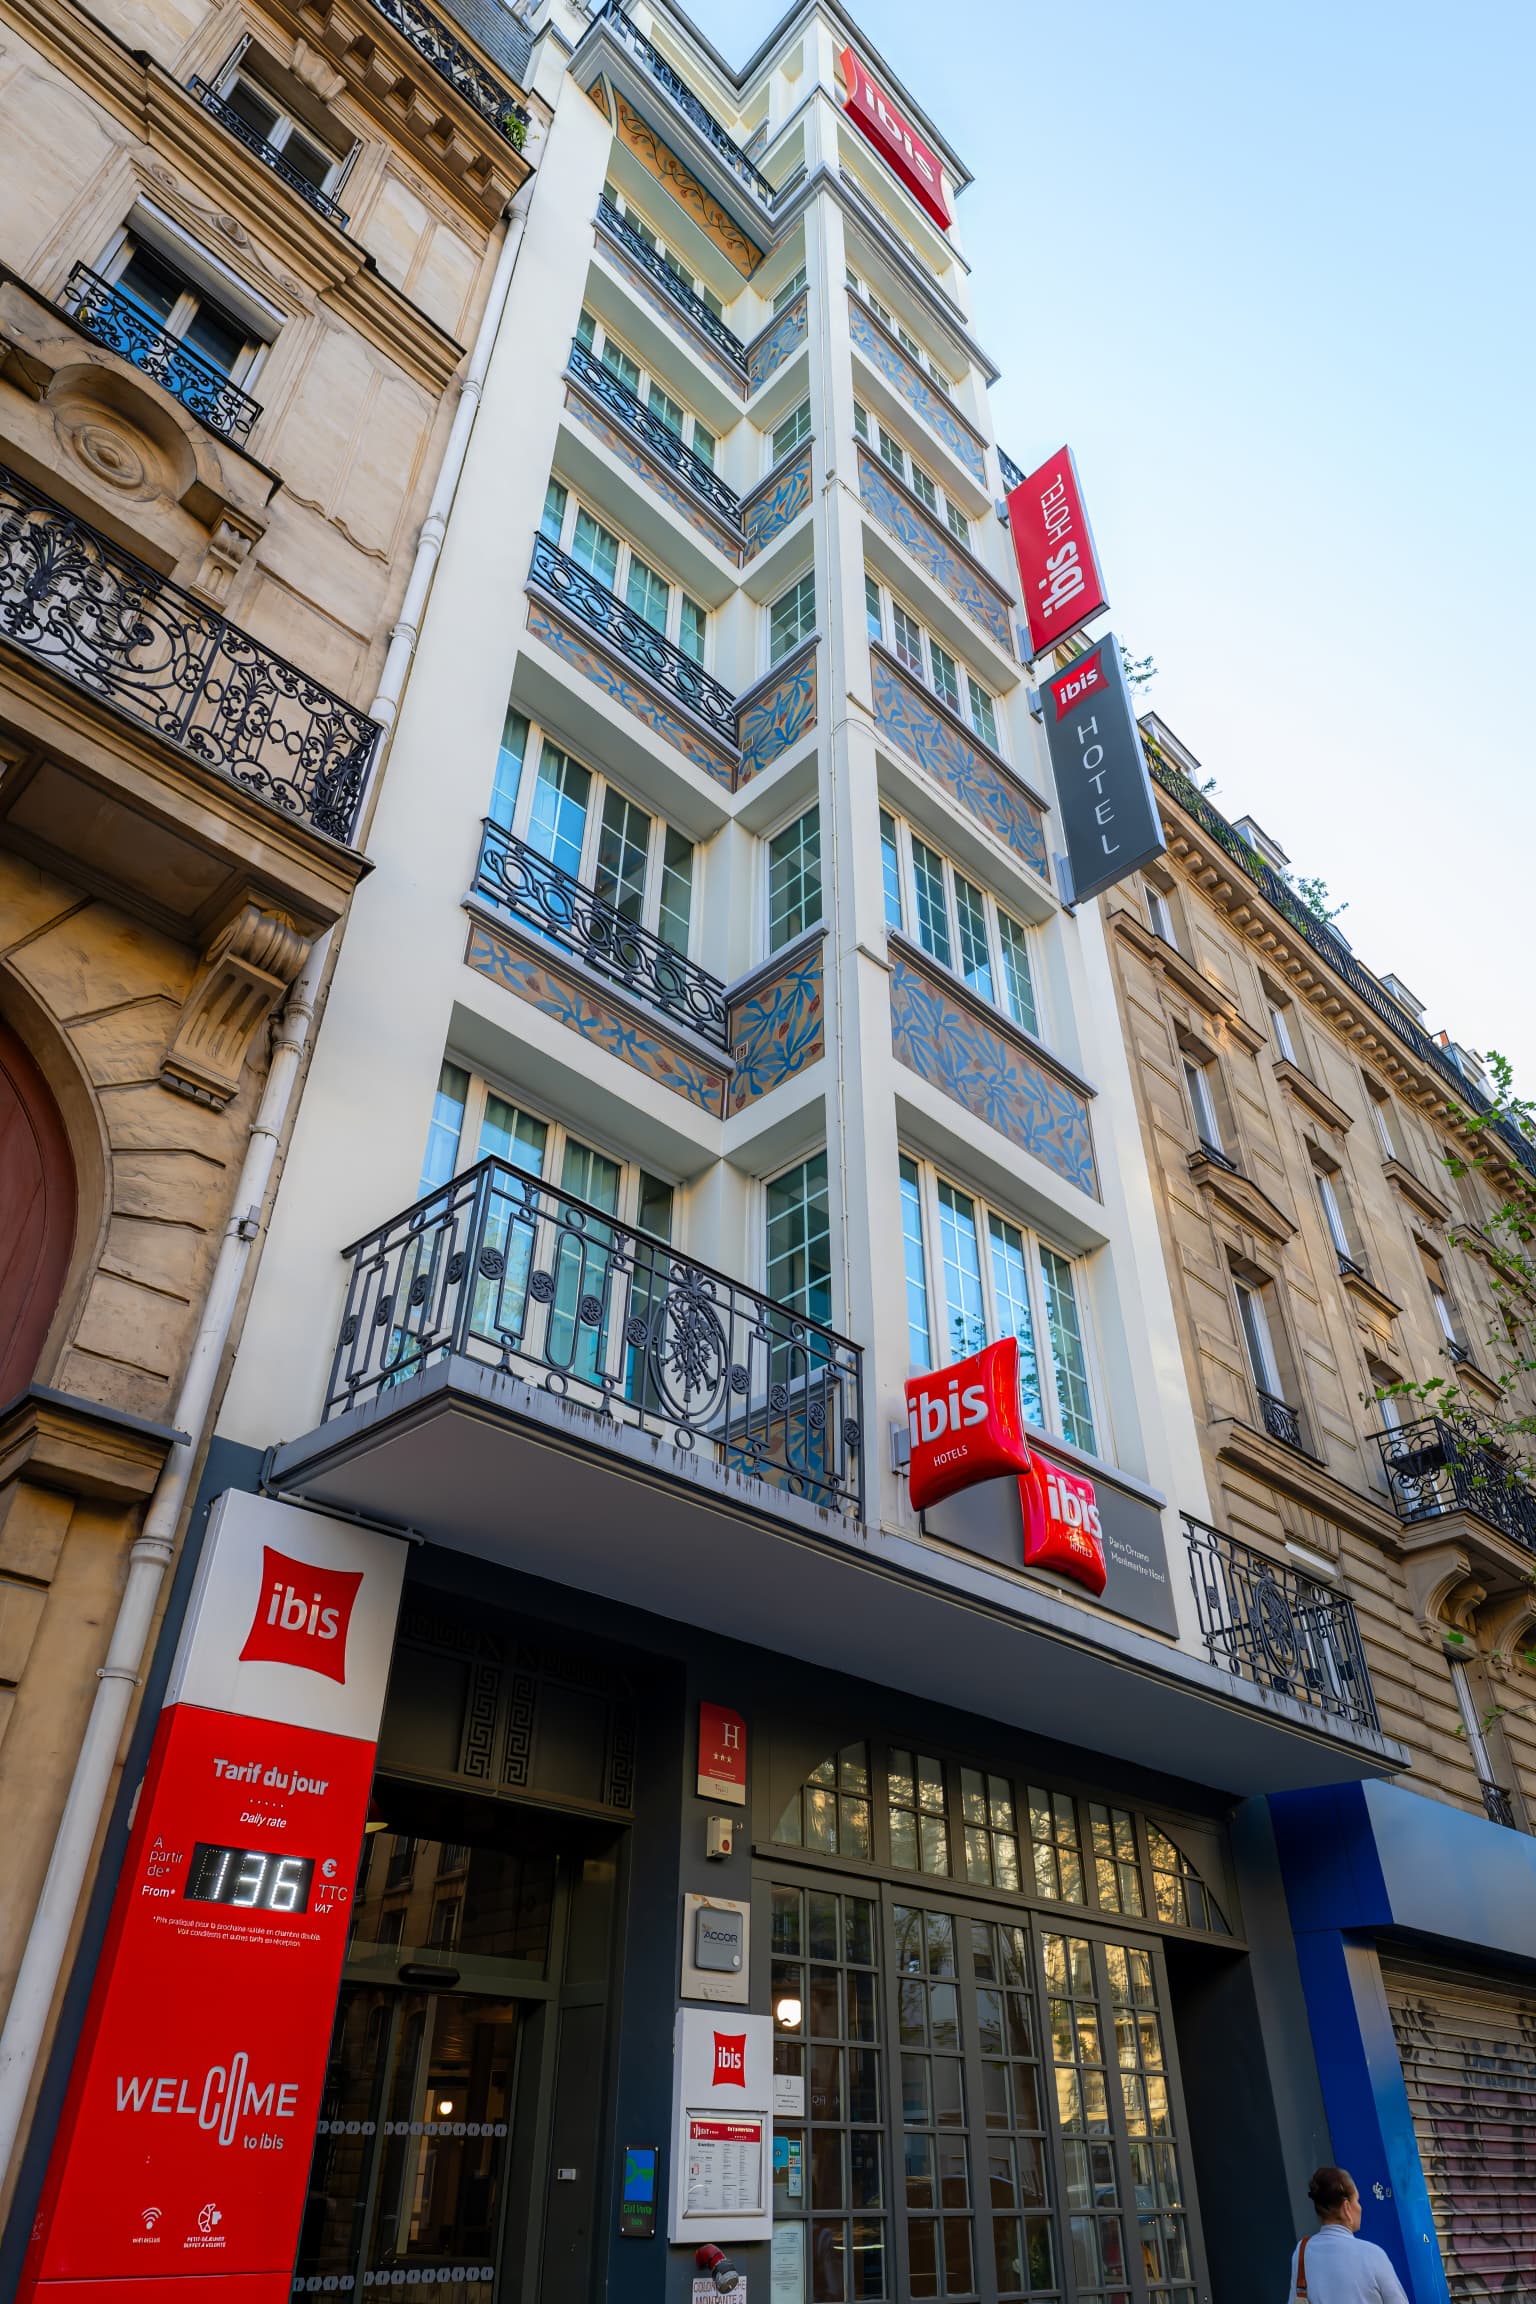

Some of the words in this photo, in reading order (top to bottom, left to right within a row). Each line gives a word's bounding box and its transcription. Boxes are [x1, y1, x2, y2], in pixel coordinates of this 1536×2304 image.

[865, 81, 934, 182] ibis
[1040, 473, 1073, 545] HOTEL
[1038, 540, 1085, 618] ibis
[1059, 668, 1099, 704] ibis
[1077, 715, 1120, 855] HOTEL
[908, 1379, 989, 1449] ibis
[933, 1444, 968, 1467] HOTELS
[1047, 1474, 1103, 1539] ibis
[1069, 1541, 1093, 1558] HOTELS
[266, 1582, 340, 1640] ibis
[721, 1721, 741, 1750] H
[213, 1758, 261, 1784] Tarif
[263, 1767, 289, 1789] du
[288, 1770, 329, 1796] jour
[240, 1812, 265, 1827] Daily
[266, 1817, 287, 1829] rate
[149, 1850, 184, 1865] partir
[321, 1858, 338, 1878] €
[213, 1852, 303, 1911] 136
[319, 1884, 348, 1901] TTC
[314, 1903, 333, 1914] VAT
[703, 1930, 738, 1943] ACCOR
[718, 2046, 742, 2069] ibis
[116, 2052, 299, 2146] WELCOME
[243, 2135, 257, 2149] to
[259, 2133, 285, 2150] ibis
